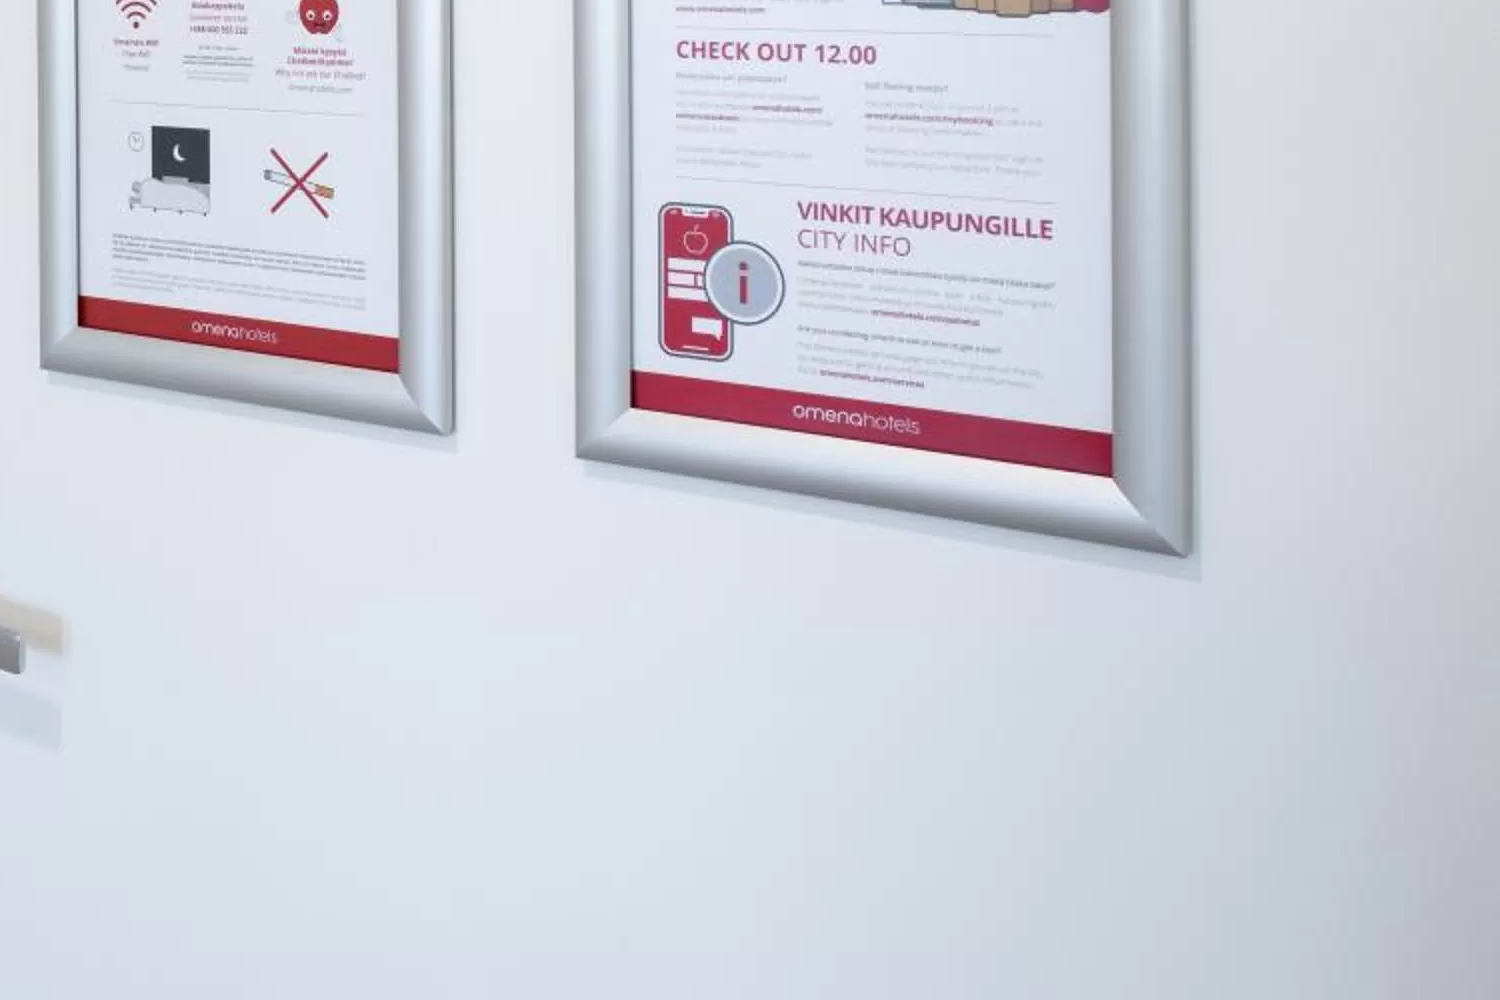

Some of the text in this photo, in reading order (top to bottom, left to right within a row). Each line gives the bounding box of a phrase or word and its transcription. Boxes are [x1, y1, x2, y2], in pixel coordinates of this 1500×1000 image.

[677, 40, 877, 65] CHECK OUT 12.00
[797, 201, 1053, 241] VINKIT KAUPUNGILLE
[797, 229, 911, 257] CITY INFO
[192, 320, 278, 344] omenahotels
[793, 404, 920, 434] omenahotels
